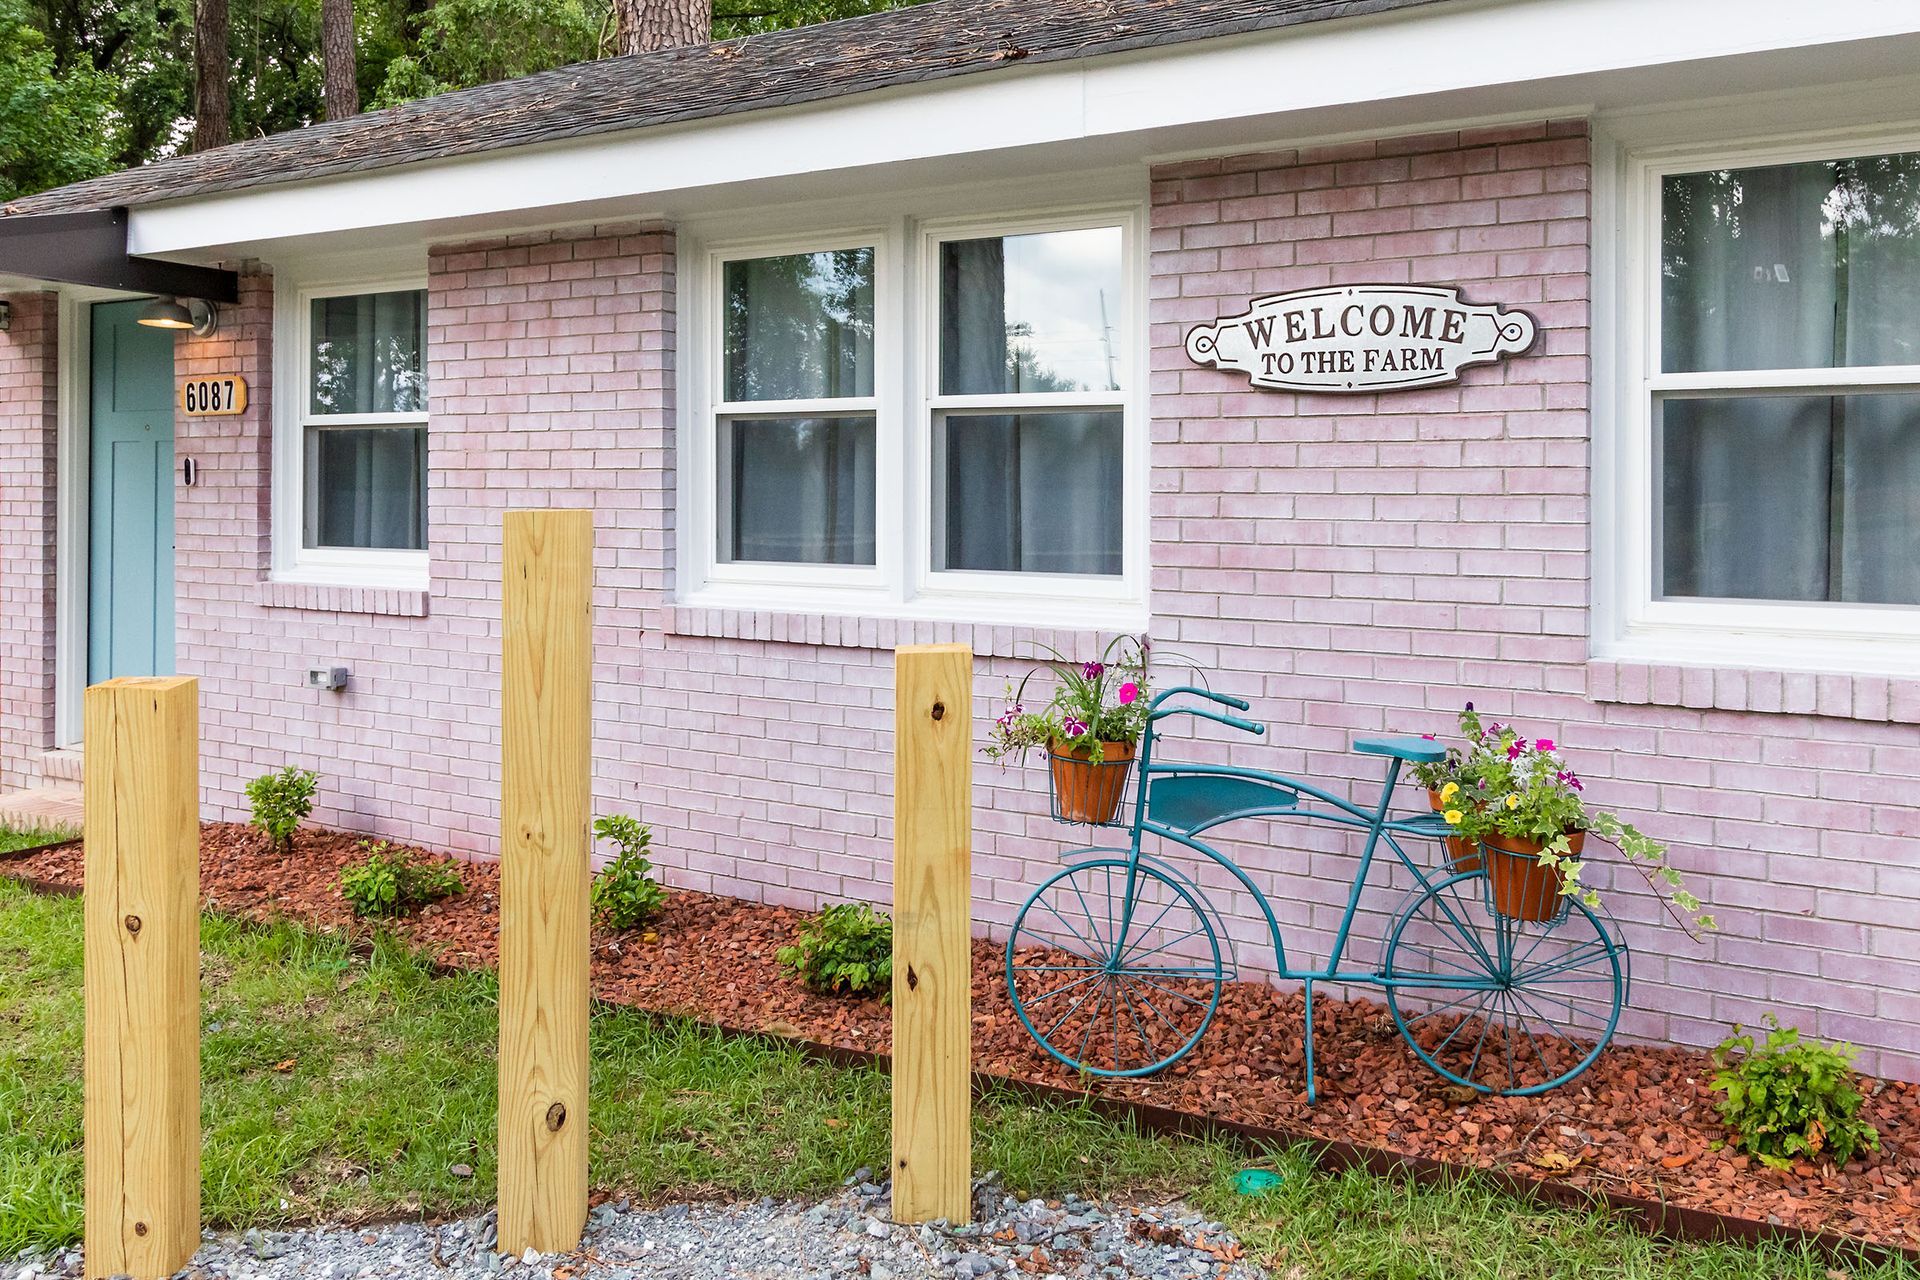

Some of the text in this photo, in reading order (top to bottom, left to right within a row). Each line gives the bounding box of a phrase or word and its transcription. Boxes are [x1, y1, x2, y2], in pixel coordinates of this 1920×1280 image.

[1242, 304, 1468, 350] WELCOME
[1261, 347, 1445, 375] TO THE FARM
[186, 380, 234, 412] 6087
